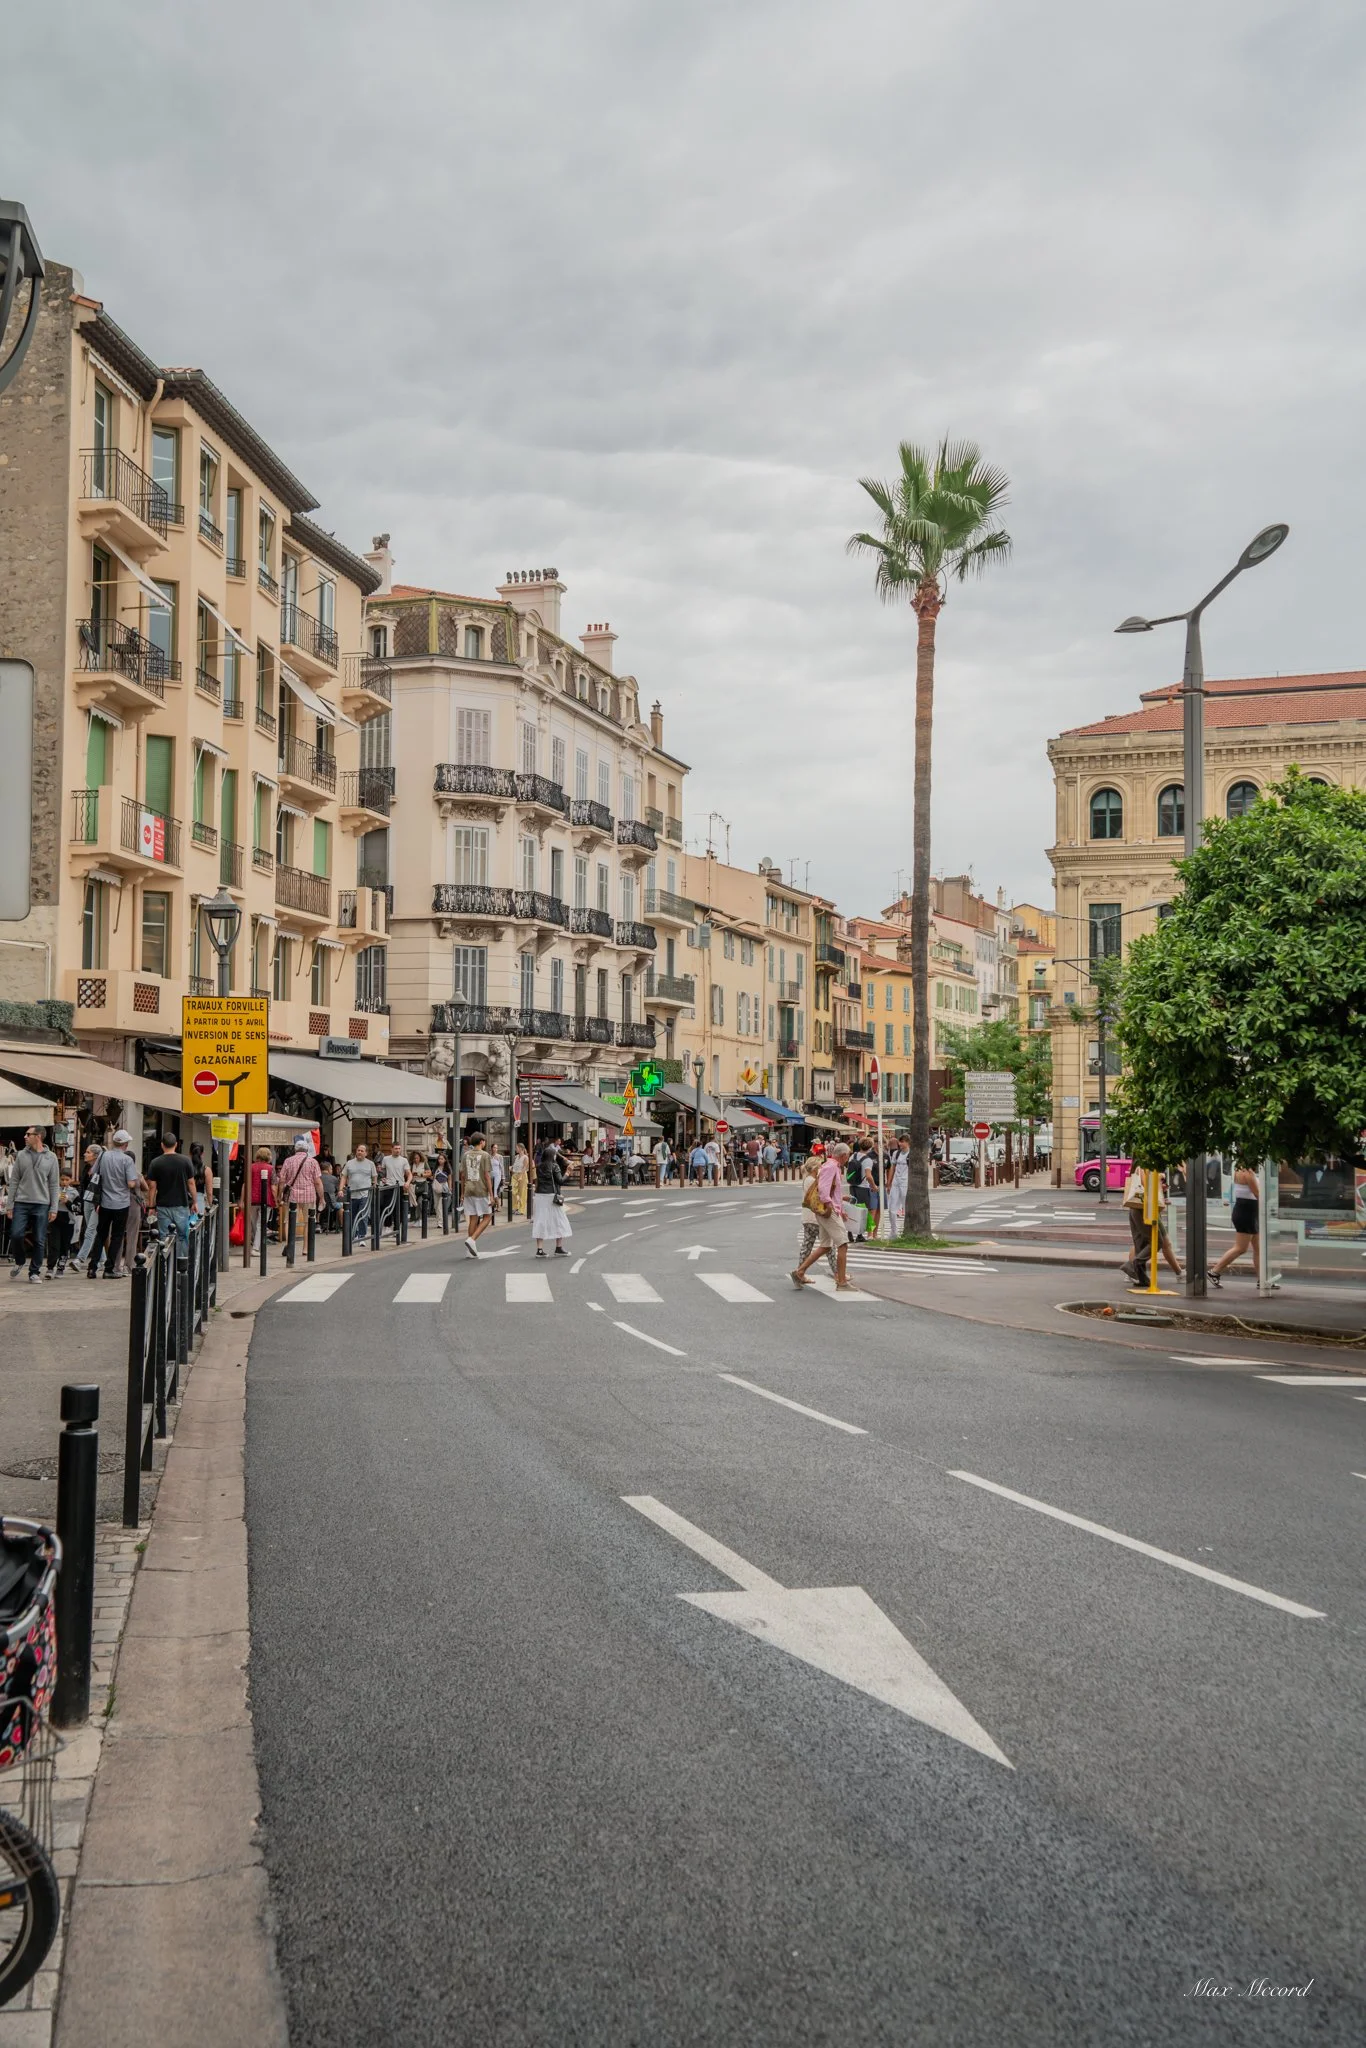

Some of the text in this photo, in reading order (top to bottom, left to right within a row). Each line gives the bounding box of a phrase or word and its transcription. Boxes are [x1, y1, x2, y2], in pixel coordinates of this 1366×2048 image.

[187, 1000, 265, 1011] TRAVAUX FORVILLE
[194, 1018, 219, 1026] PARTIR
[220, 1018, 231, 1026] DU
[234, 1018, 244, 1026] 15
[246, 1018, 265, 1026] AVRIL
[185, 1031, 266, 1040] INVERSION DE SENS
[216, 1044, 236, 1053] RUE
[194, 1055, 258, 1065] GAZAGNAIRE
